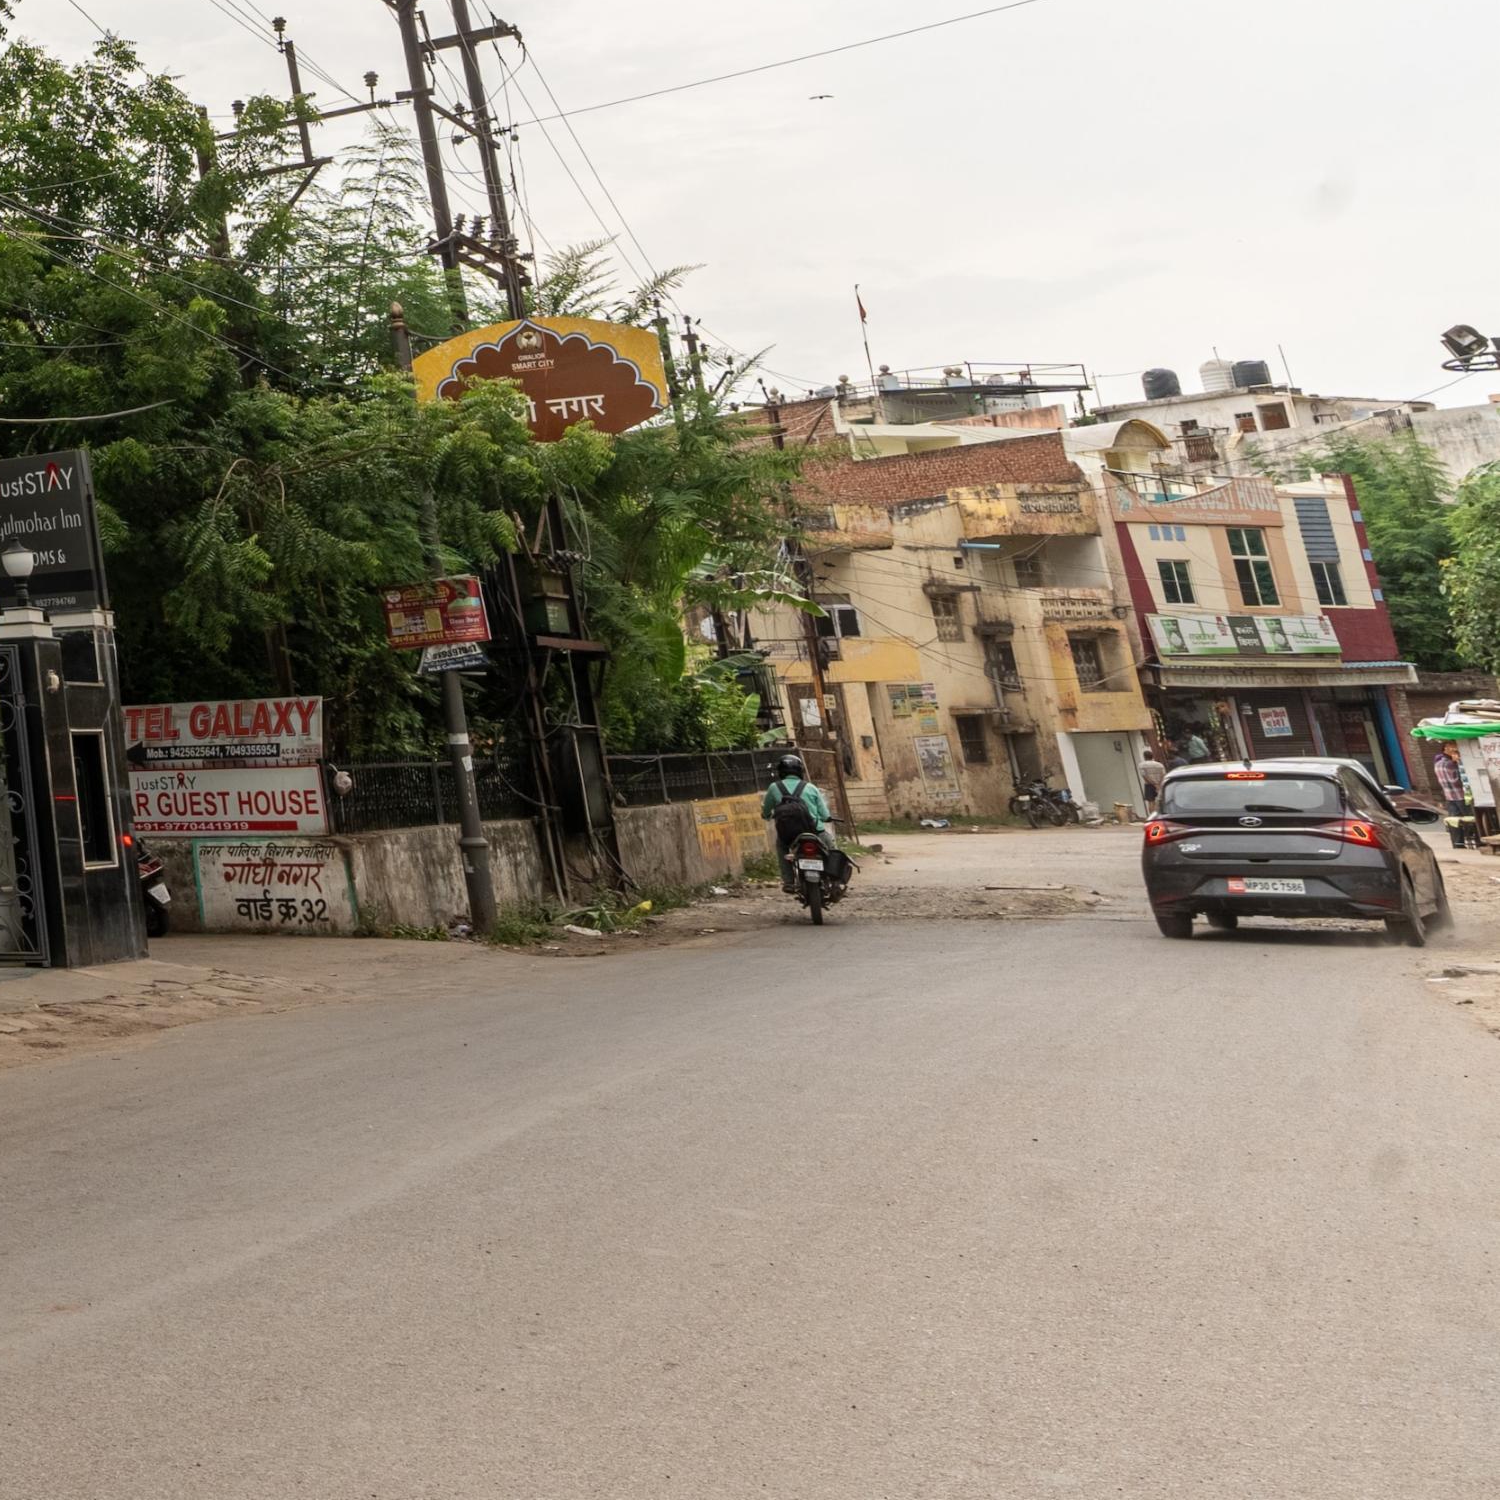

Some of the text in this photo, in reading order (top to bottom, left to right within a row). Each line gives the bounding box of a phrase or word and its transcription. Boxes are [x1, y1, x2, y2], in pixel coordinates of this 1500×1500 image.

[512, 359, 555, 370] SMART CITY
[545, 394, 606, 420] नगर
[61, 508, 82, 529] Inn
[124, 700, 319, 741] TEL GALAXY
[135, 772, 197, 792] JustSTAY
[157, 791, 230, 817] GUEST
[238, 790, 320, 816] HOUSE
[135, 821, 249, 831] +91-9770441919
[223, 857, 325, 894] गांधी नगर
[235, 889, 274, 921] वार्ड
